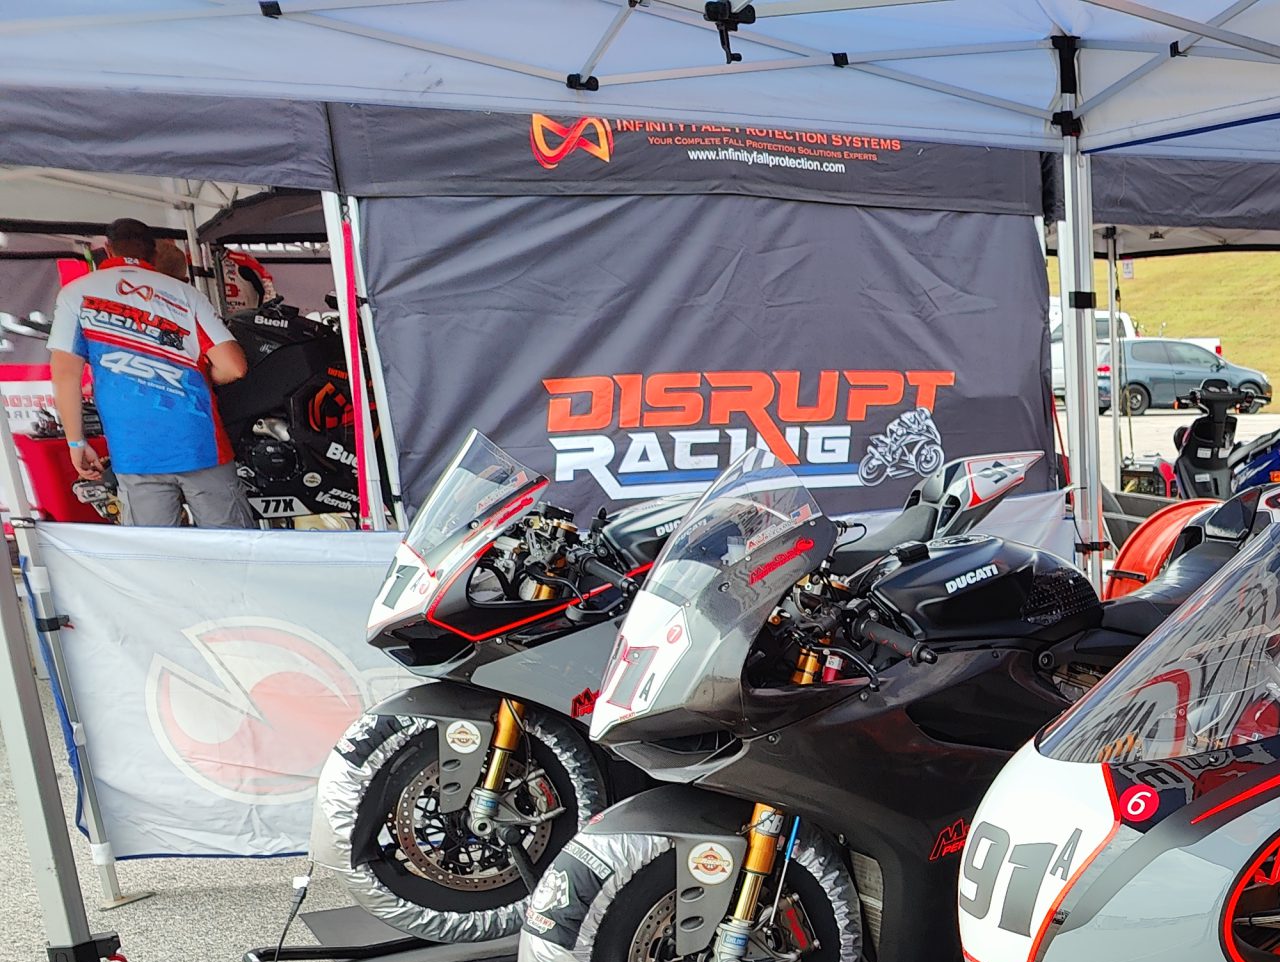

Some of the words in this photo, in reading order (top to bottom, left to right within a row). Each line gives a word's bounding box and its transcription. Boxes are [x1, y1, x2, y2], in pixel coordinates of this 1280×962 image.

[648, 136, 673, 145] YOUR
[674, 136, 721, 145] COMPLETE
[723, 137, 744, 147] FALL
[746, 140, 796, 153] PROTECTION
[797, 146, 843, 159] SOLUTIONS
[843, 151, 878, 161] EXPERTS
[832, 134, 902, 151] SYSTEMS
[687, 147, 846, 174] www.infinityfallprotection.com
[80, 307, 161, 337] RACING
[82, 295, 191, 338] DISRUPT
[254, 315, 289, 329] Buell
[542, 370, 957, 435] DISRUPT
[548, 425, 852, 482] RACING
[261, 498, 295, 514] 77X
[945, 563, 999, 594] DUCATI
[1126, 791, 1151, 816] 6
[960, 821, 1058, 938] 91
[1050, 827, 1083, 881] A
